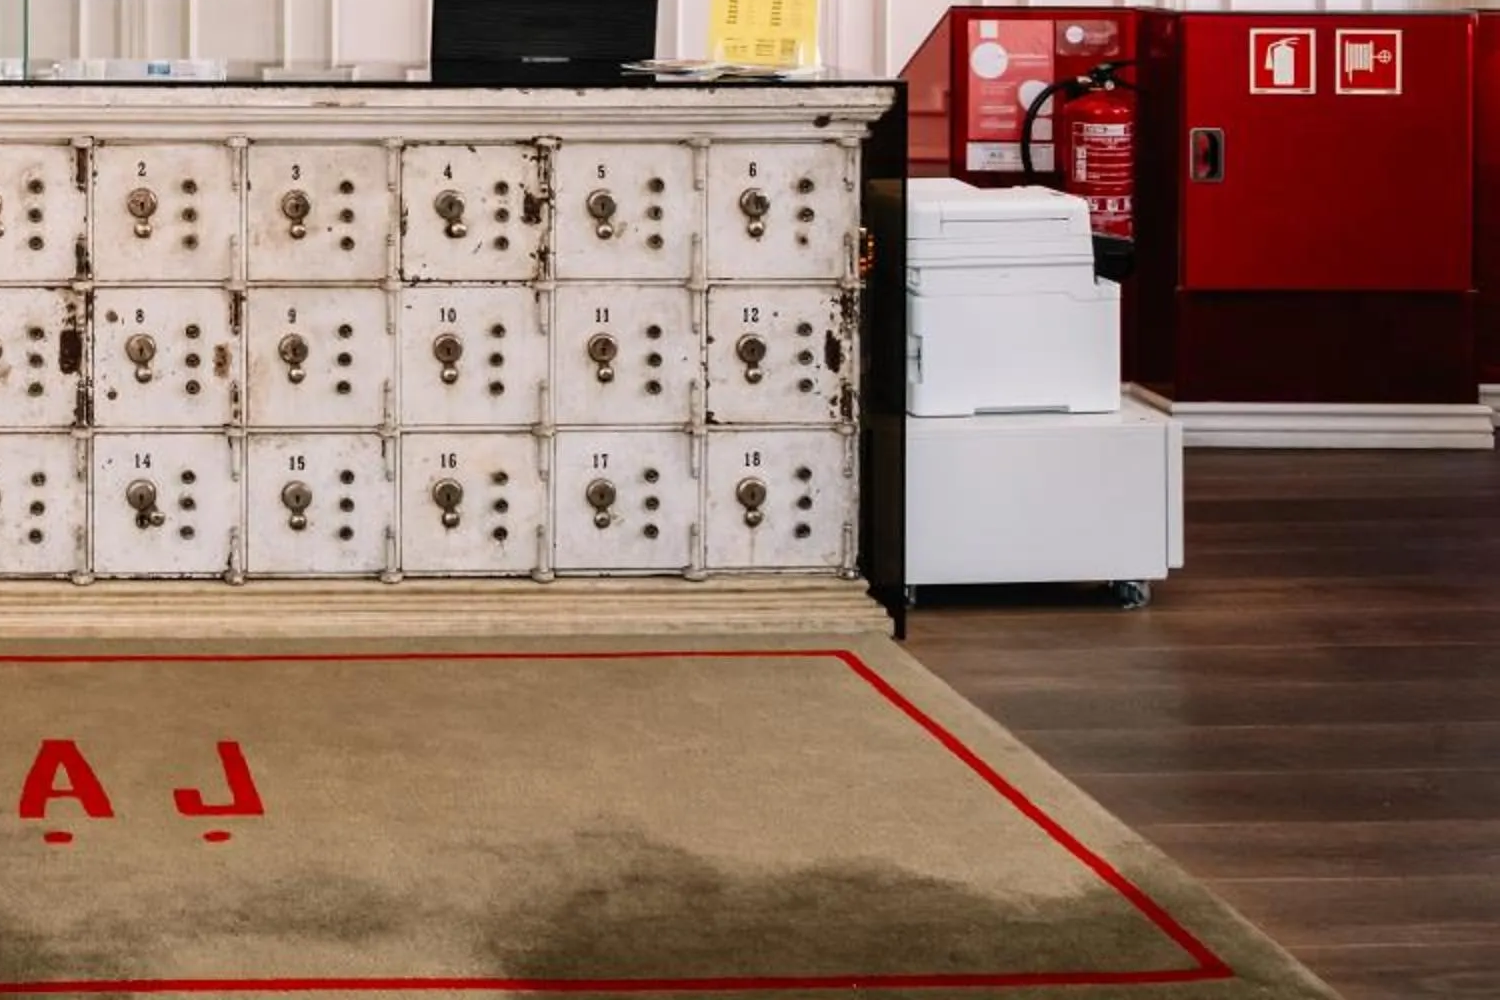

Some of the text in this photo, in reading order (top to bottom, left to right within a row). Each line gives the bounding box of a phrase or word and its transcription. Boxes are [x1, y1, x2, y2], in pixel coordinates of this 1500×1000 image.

[137, 161, 147, 177] 2
[291, 164, 301, 181] 3
[443, 163, 453, 180] 4
[597, 164, 606, 179] 5
[748, 161, 757, 178] 6
[135, 308, 144, 324] 8
[287, 307, 297, 325] 9
[440, 307, 457, 324] 10
[595, 307, 609, 323] 11
[743, 307, 759, 323] 12
[135, 453, 151, 469] 14
[289, 455, 306, 471] 15
[441, 452, 457, 469] 16
[593, 453, 608, 469] 17
[745, 451, 761, 467] 18
